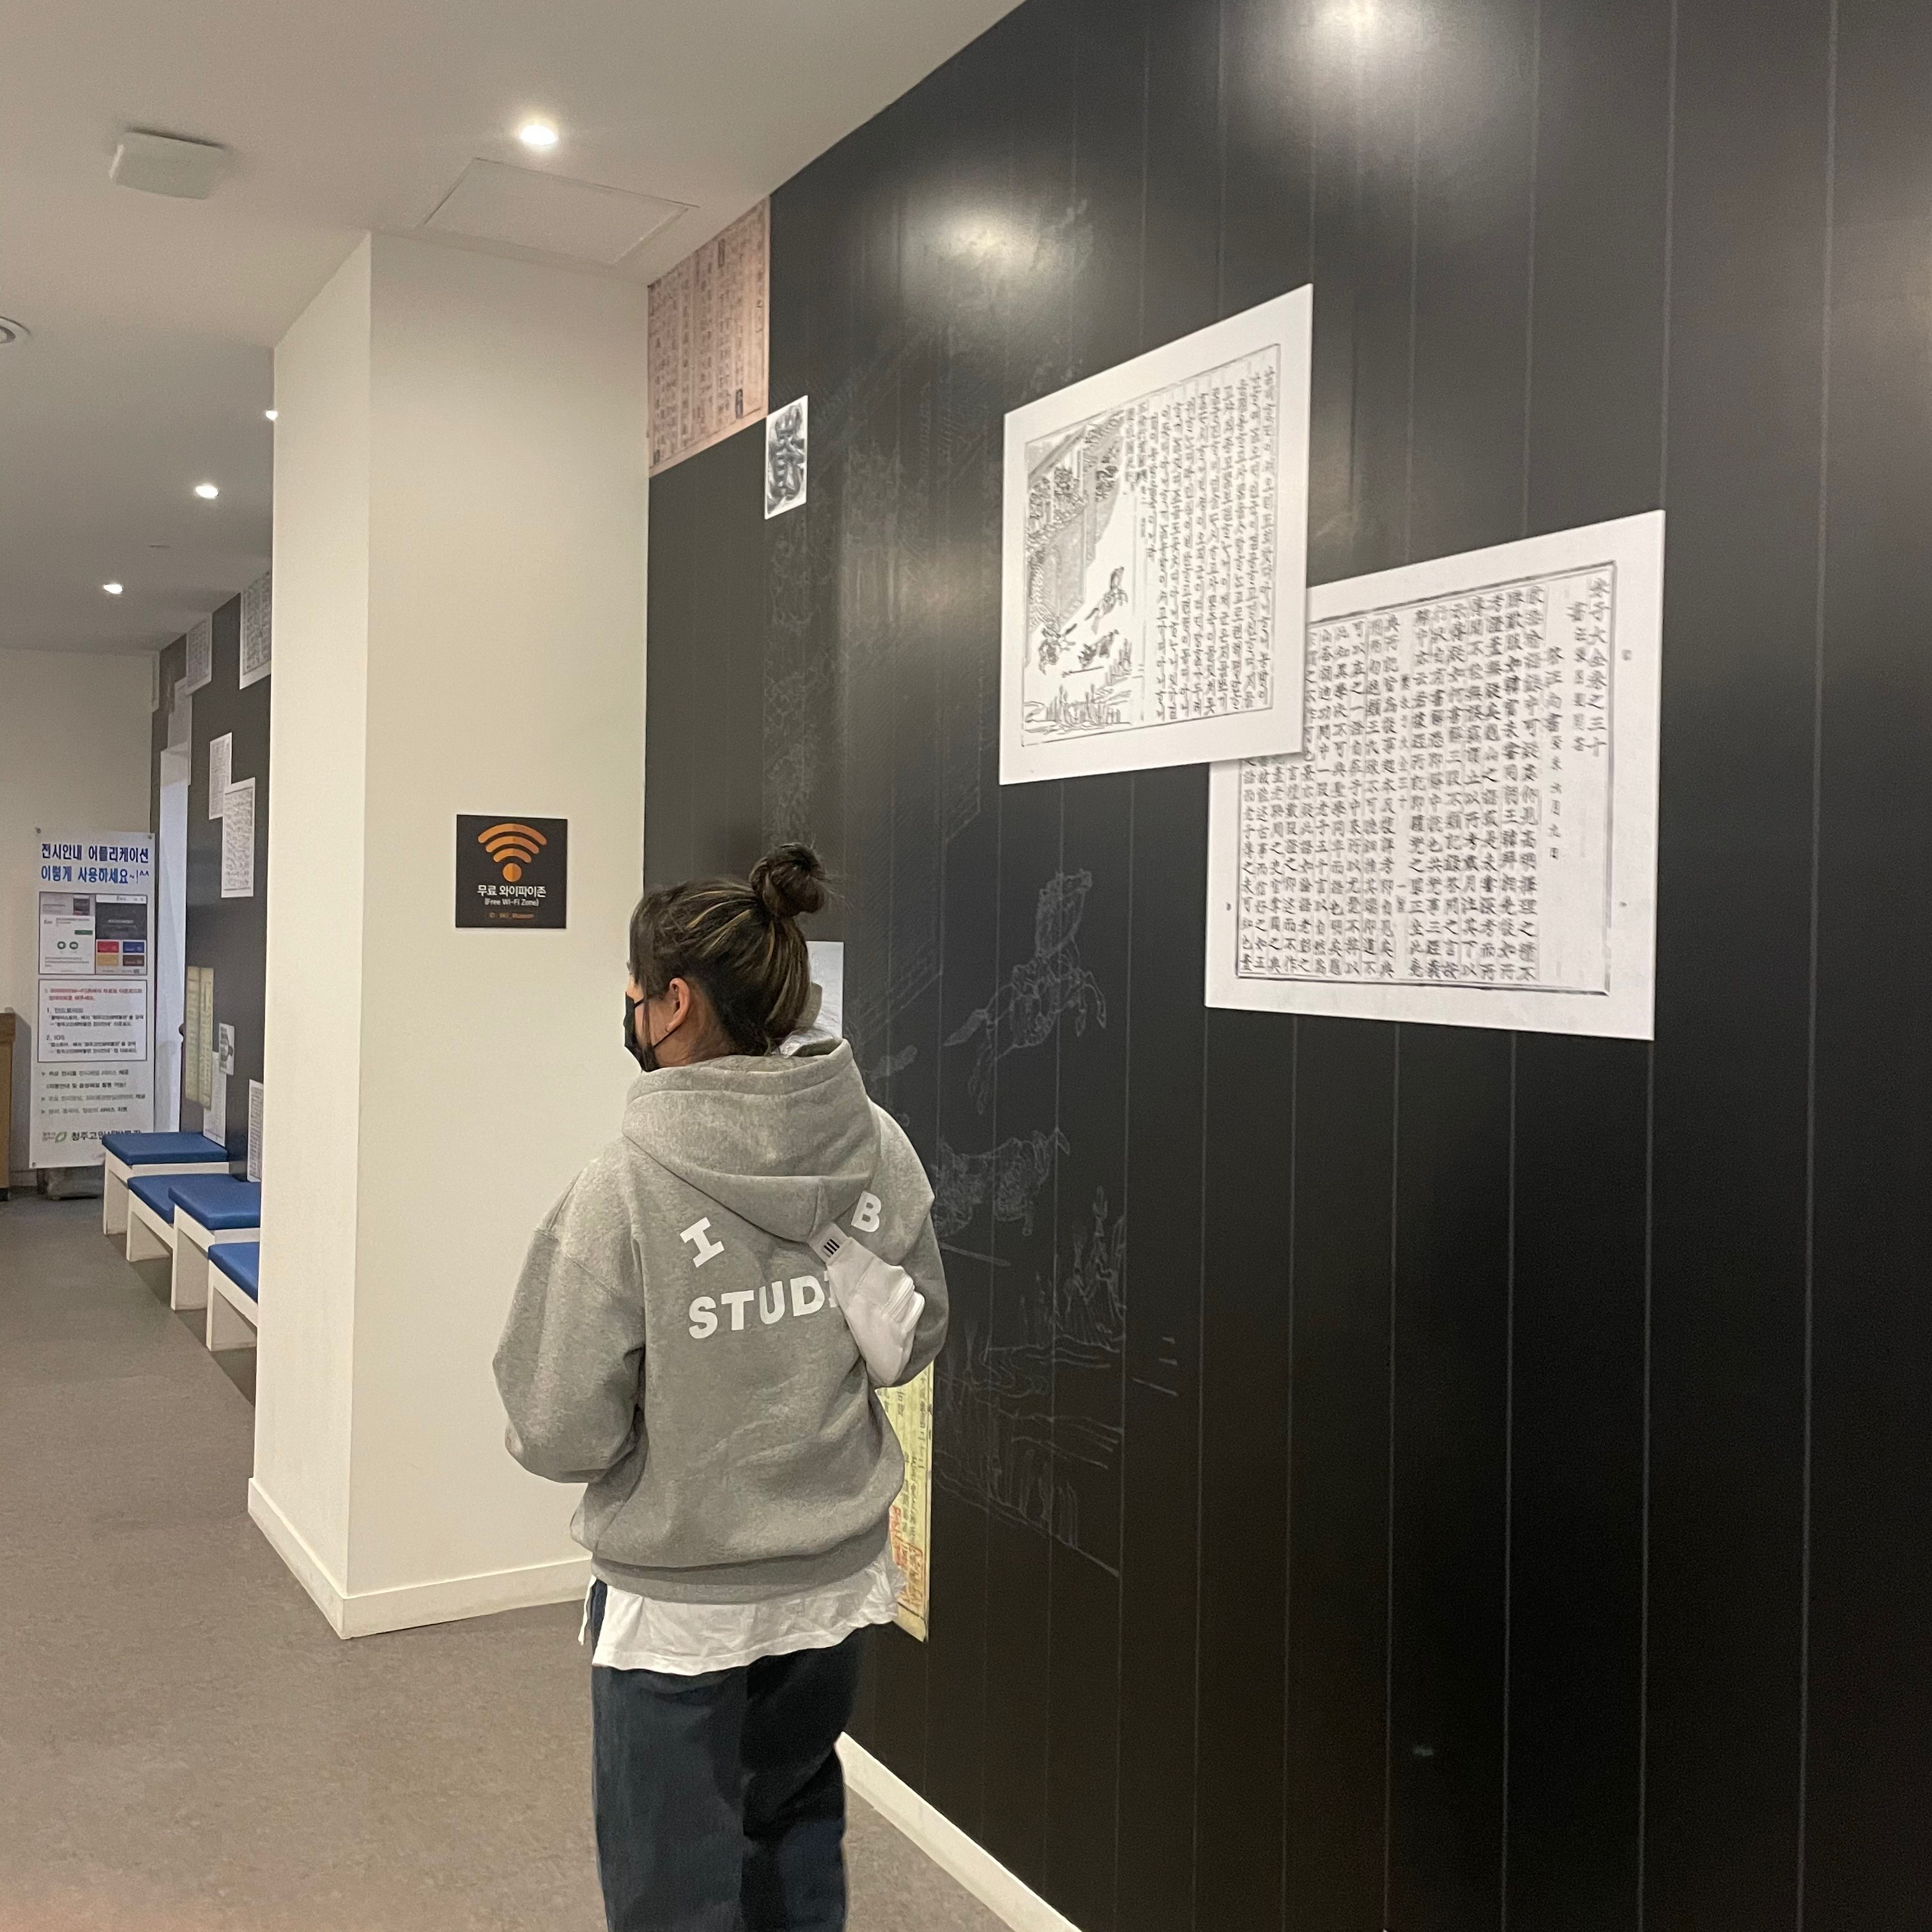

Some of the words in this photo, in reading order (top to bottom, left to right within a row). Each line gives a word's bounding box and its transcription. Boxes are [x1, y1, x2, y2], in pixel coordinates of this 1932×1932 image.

[42, 843, 82, 861] 전시안내
[88, 845, 149, 863] 어플리케이션
[42, 865, 72, 882] 이렇게
[477, 885, 497, 896] 무료
[499, 885, 546, 898] 와이파이존
[689, 1271, 838, 1339] STUD
